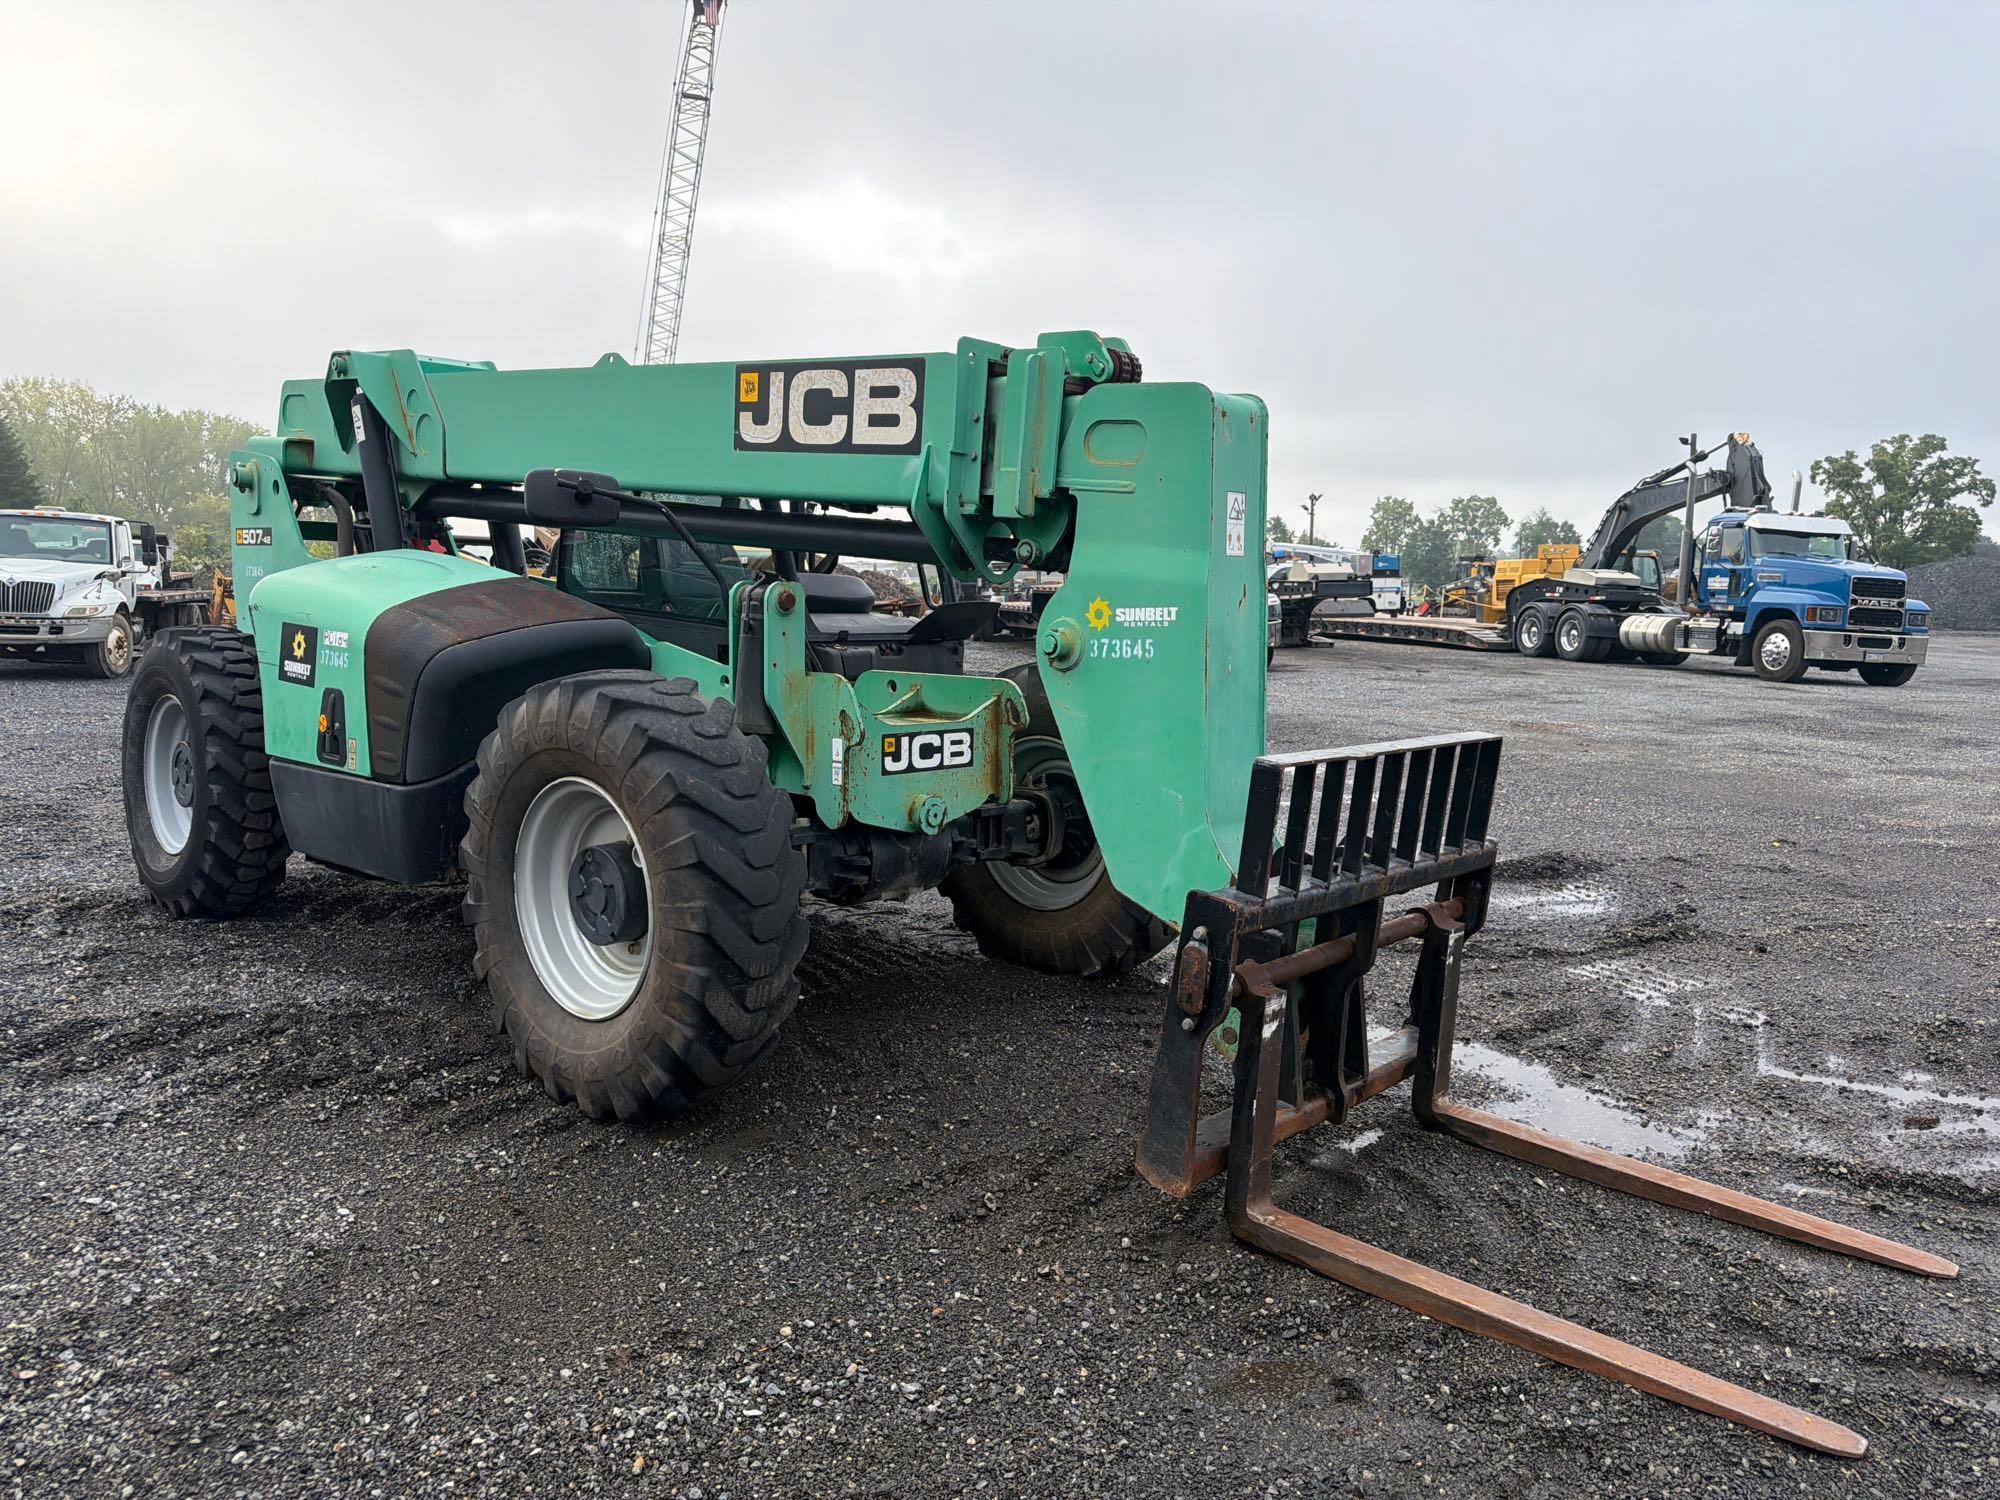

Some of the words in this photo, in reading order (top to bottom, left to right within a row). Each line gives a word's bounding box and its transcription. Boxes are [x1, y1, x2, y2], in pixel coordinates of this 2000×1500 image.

[738, 367, 918, 446] JCB
[1857, 599, 1898, 607] MACK
[1115, 607, 1179, 622] SUNBELT
[1090, 639, 1155, 659] 373645
[283, 659, 312, 676] SUNBELT
[320, 650, 349, 669] 373645
[286, 671, 307, 680] RENTALS
[884, 732, 972, 772] JCB
